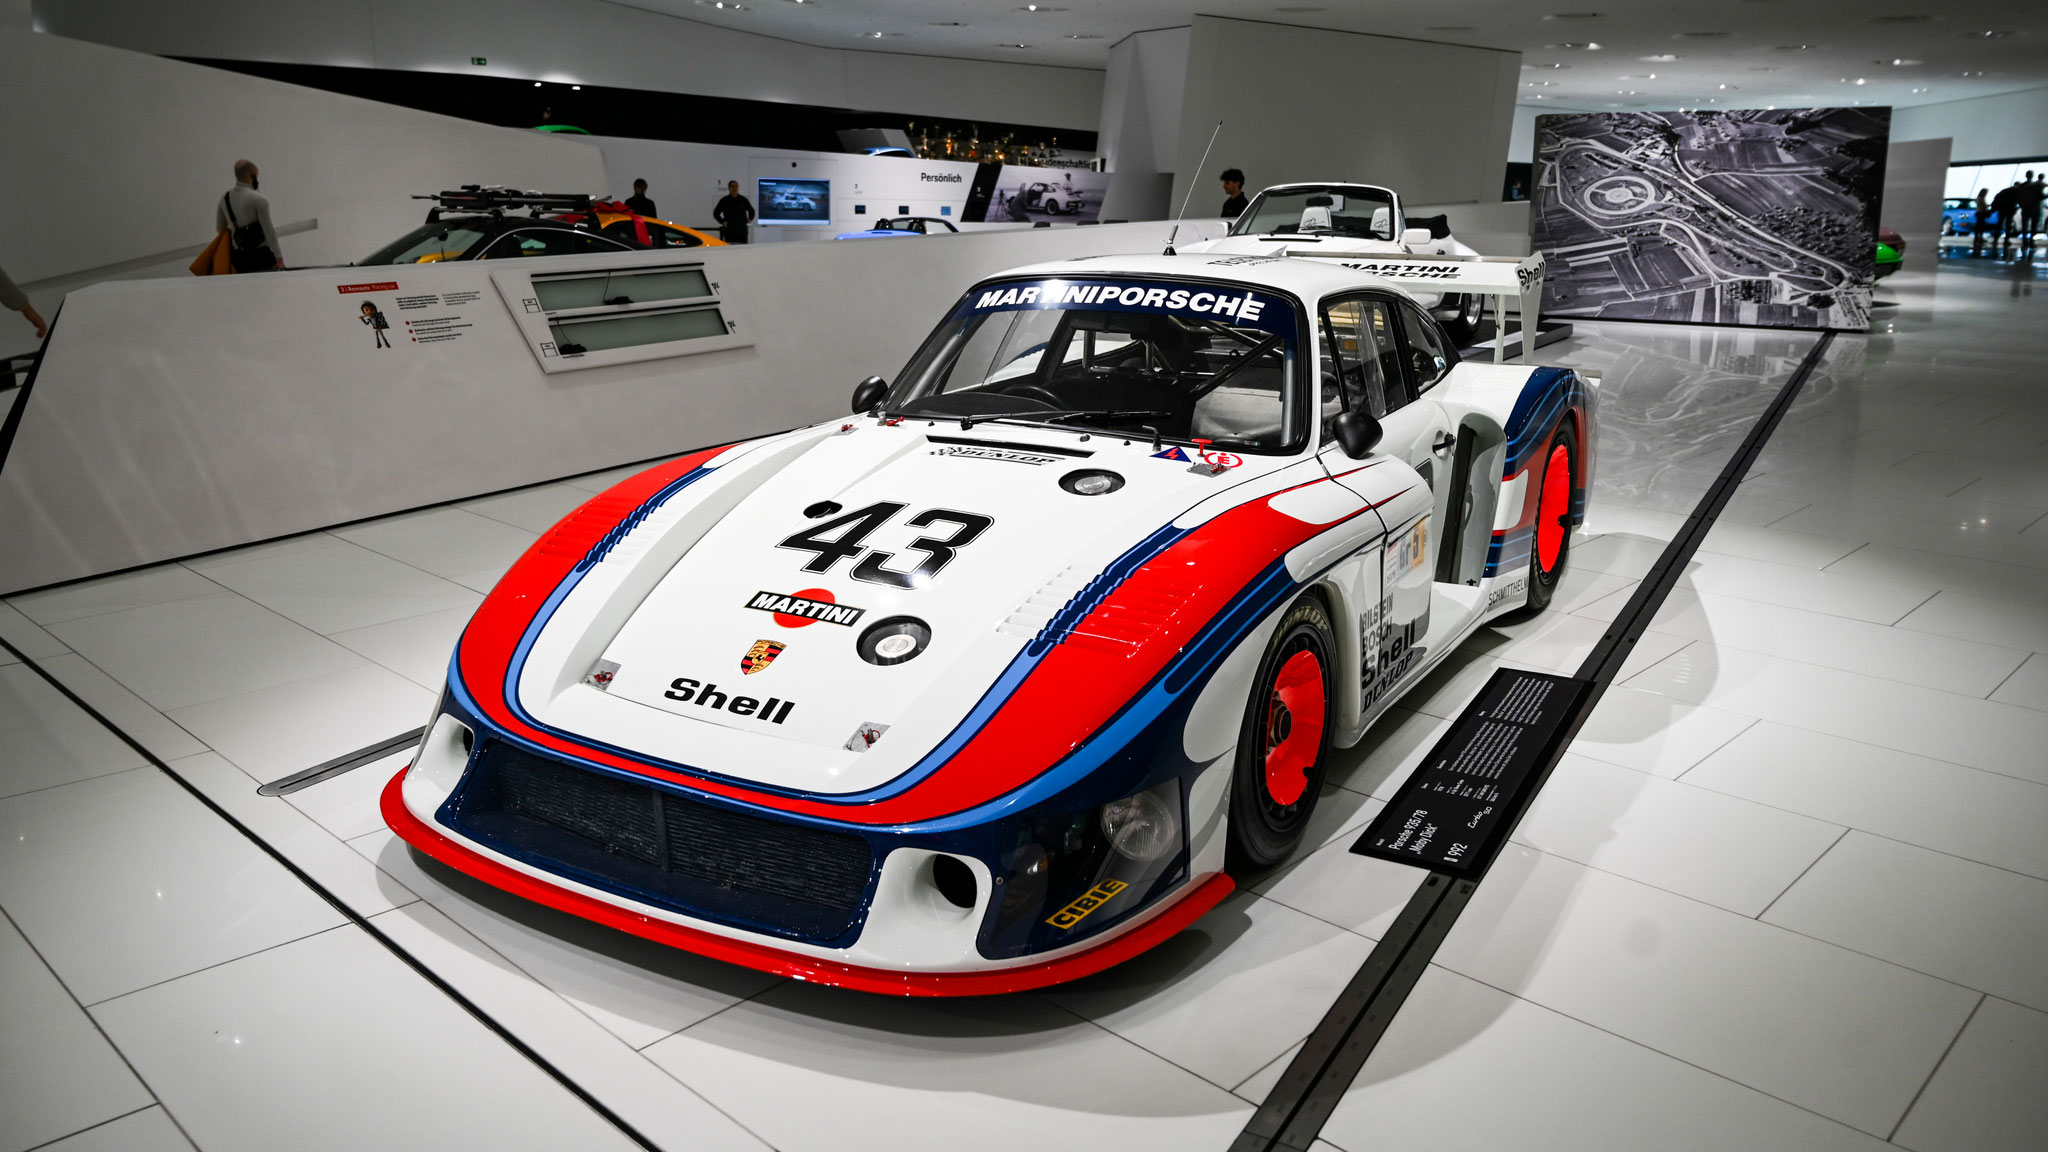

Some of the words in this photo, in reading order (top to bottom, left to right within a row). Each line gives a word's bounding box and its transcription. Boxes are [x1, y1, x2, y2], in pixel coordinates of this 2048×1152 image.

[921, 172, 962, 183] Persönlich
[1517, 261, 1545, 286] Shell
[774, 500, 995, 590] 43
[750, 593, 859, 625] MARTINI
[1361, 618, 1415, 690] Shell
[664, 677, 796, 725] Shell
[1362, 650, 1414, 713] DUNLOP
[1388, 829, 1413, 850] Porsche
[1404, 809, 1428, 829] 935/78
[1053, 880, 1124, 925] CIBIE
